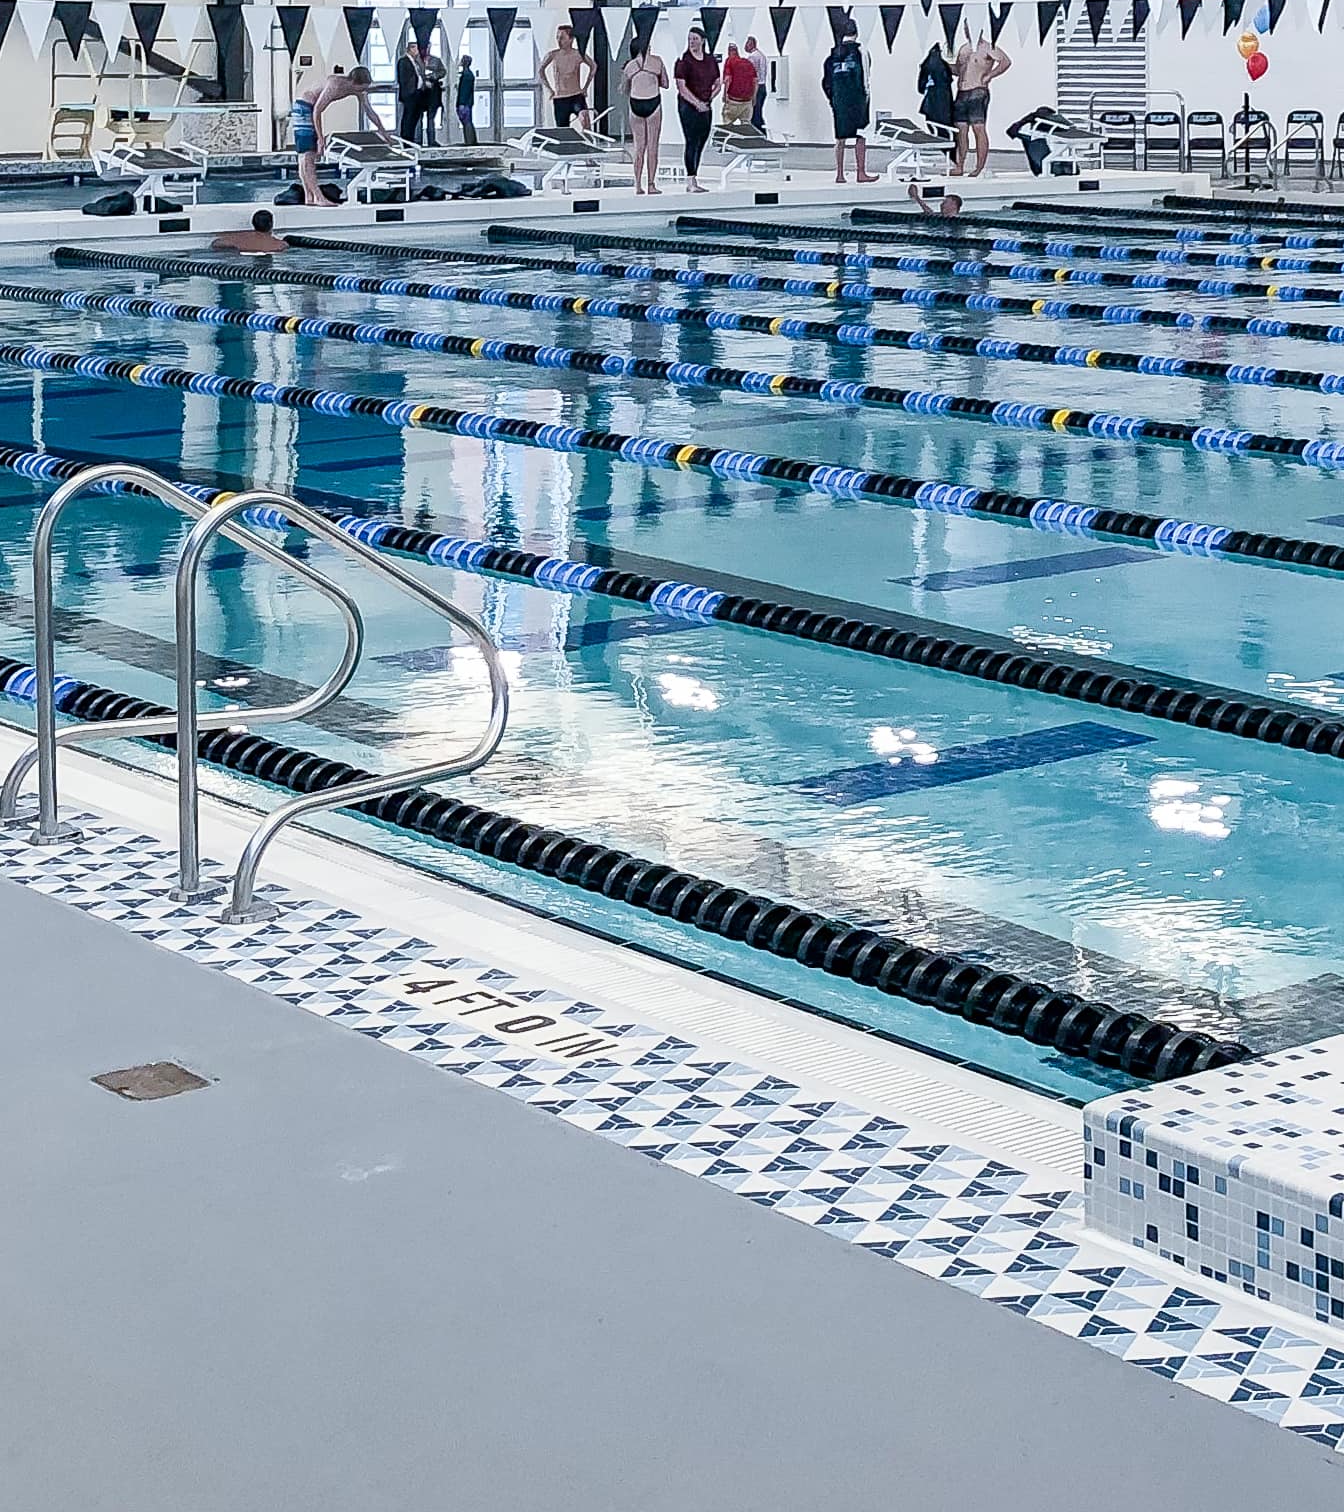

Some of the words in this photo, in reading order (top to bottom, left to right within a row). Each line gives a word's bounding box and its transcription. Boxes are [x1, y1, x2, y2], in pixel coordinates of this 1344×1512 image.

[403, 980, 458, 995] 4
[432, 991, 519, 1016] FT
[535, 1032, 619, 1058] IN
